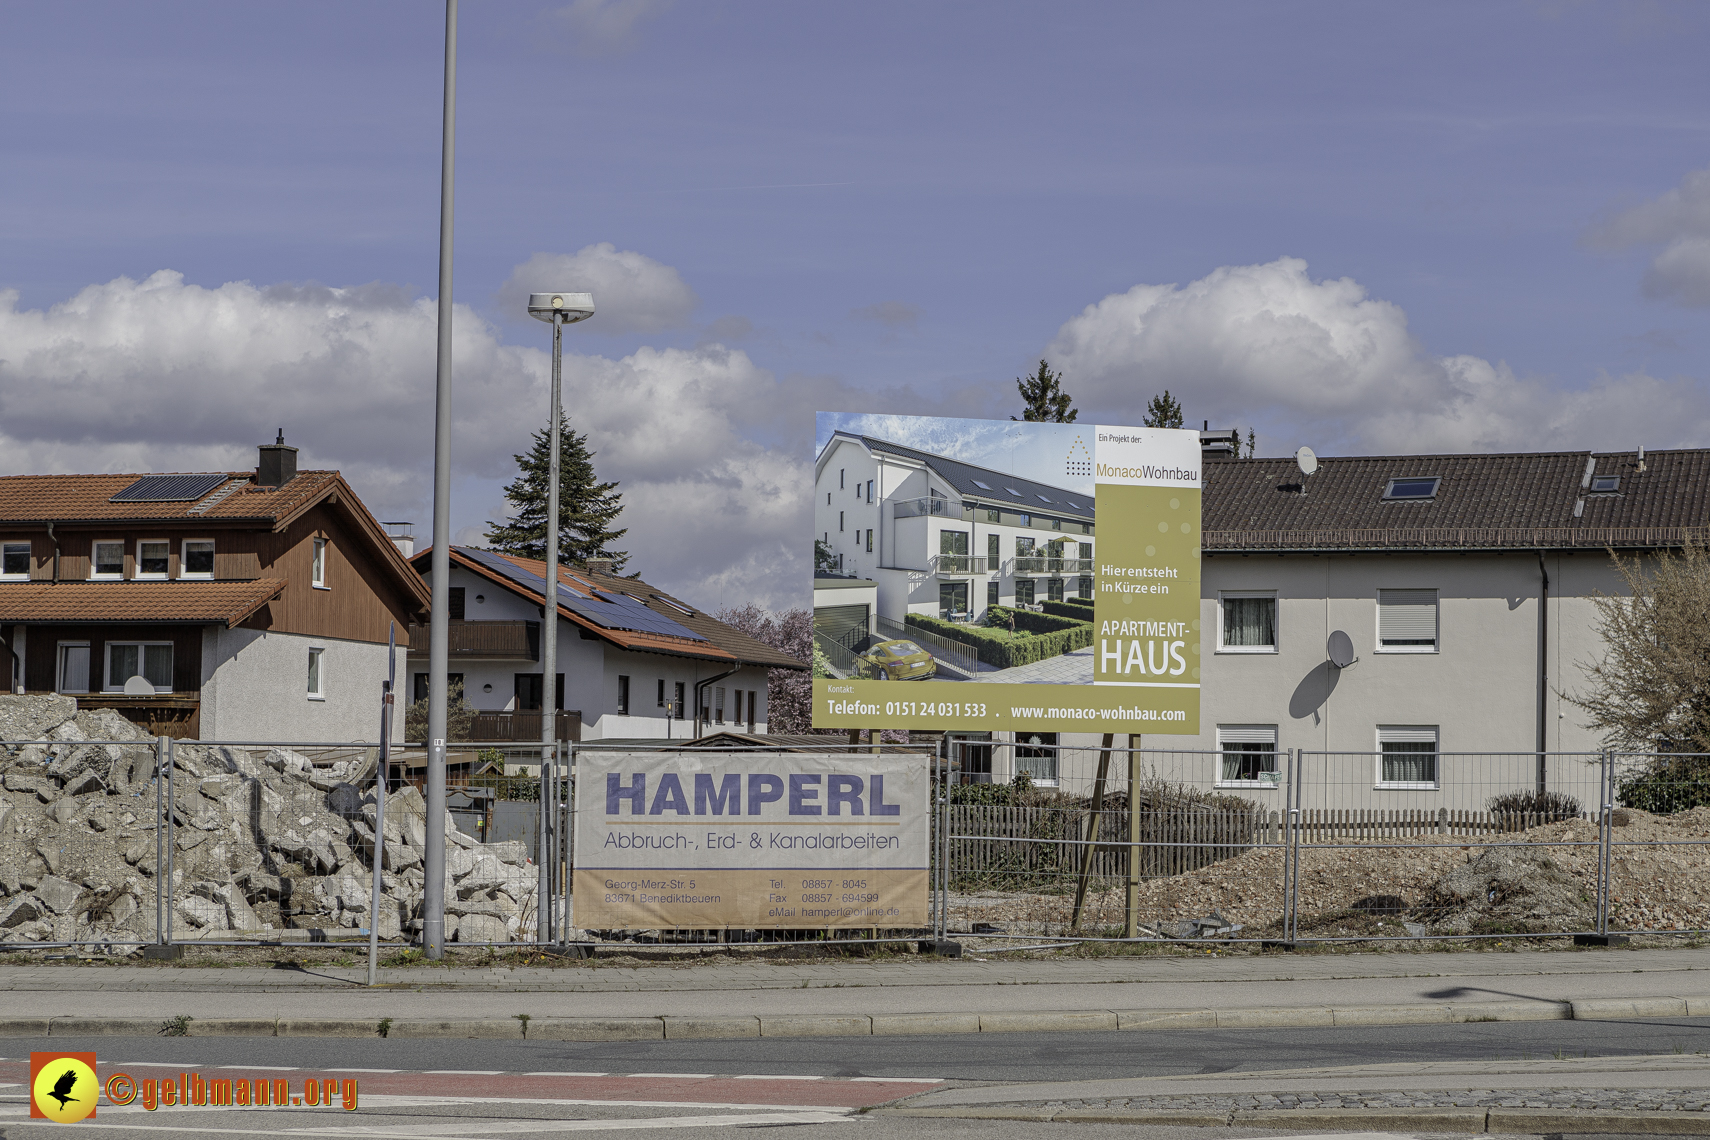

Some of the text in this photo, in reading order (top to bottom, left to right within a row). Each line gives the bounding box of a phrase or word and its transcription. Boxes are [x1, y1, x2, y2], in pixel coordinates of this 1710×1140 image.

[1099, 433, 1141, 444] Ein Projekt der:
[1097, 464, 1197, 480] MonacoWohnbau
[1102, 581, 1168, 594] in Kürze ein
[1101, 621, 1189, 637] APARTMENT-
[1102, 639, 1186, 675] HAUS
[828, 685, 854, 693] Kontakt:
[828, 700, 880, 714] Telefon:
[886, 702, 915, 715] 0151
[920, 702, 935, 716] 24
[938, 703, 959, 716] 031
[964, 704, 986, 717] 533
[1011, 706, 1185, 720] www.monaco-wohnbau.com
[606, 771, 900, 816] HAMPERL
[604, 832, 899, 850] Abbruch-, Erd- & Kanalarbeiten
[604, 879, 696, 892] Georg-Merz-Str. 5
[769, 879, 786, 889] Tel.
[802, 880, 832, 890] 08857
[843, 880, 866, 888] 8045
[605, 893, 720, 903] 83671 Benediktbeuern
[768, 894, 787, 902] Fax
[802, 894, 832, 902] 08857
[842, 893, 878, 902] 694599
[769, 906, 900, 920] eMail hamperl@online.de
